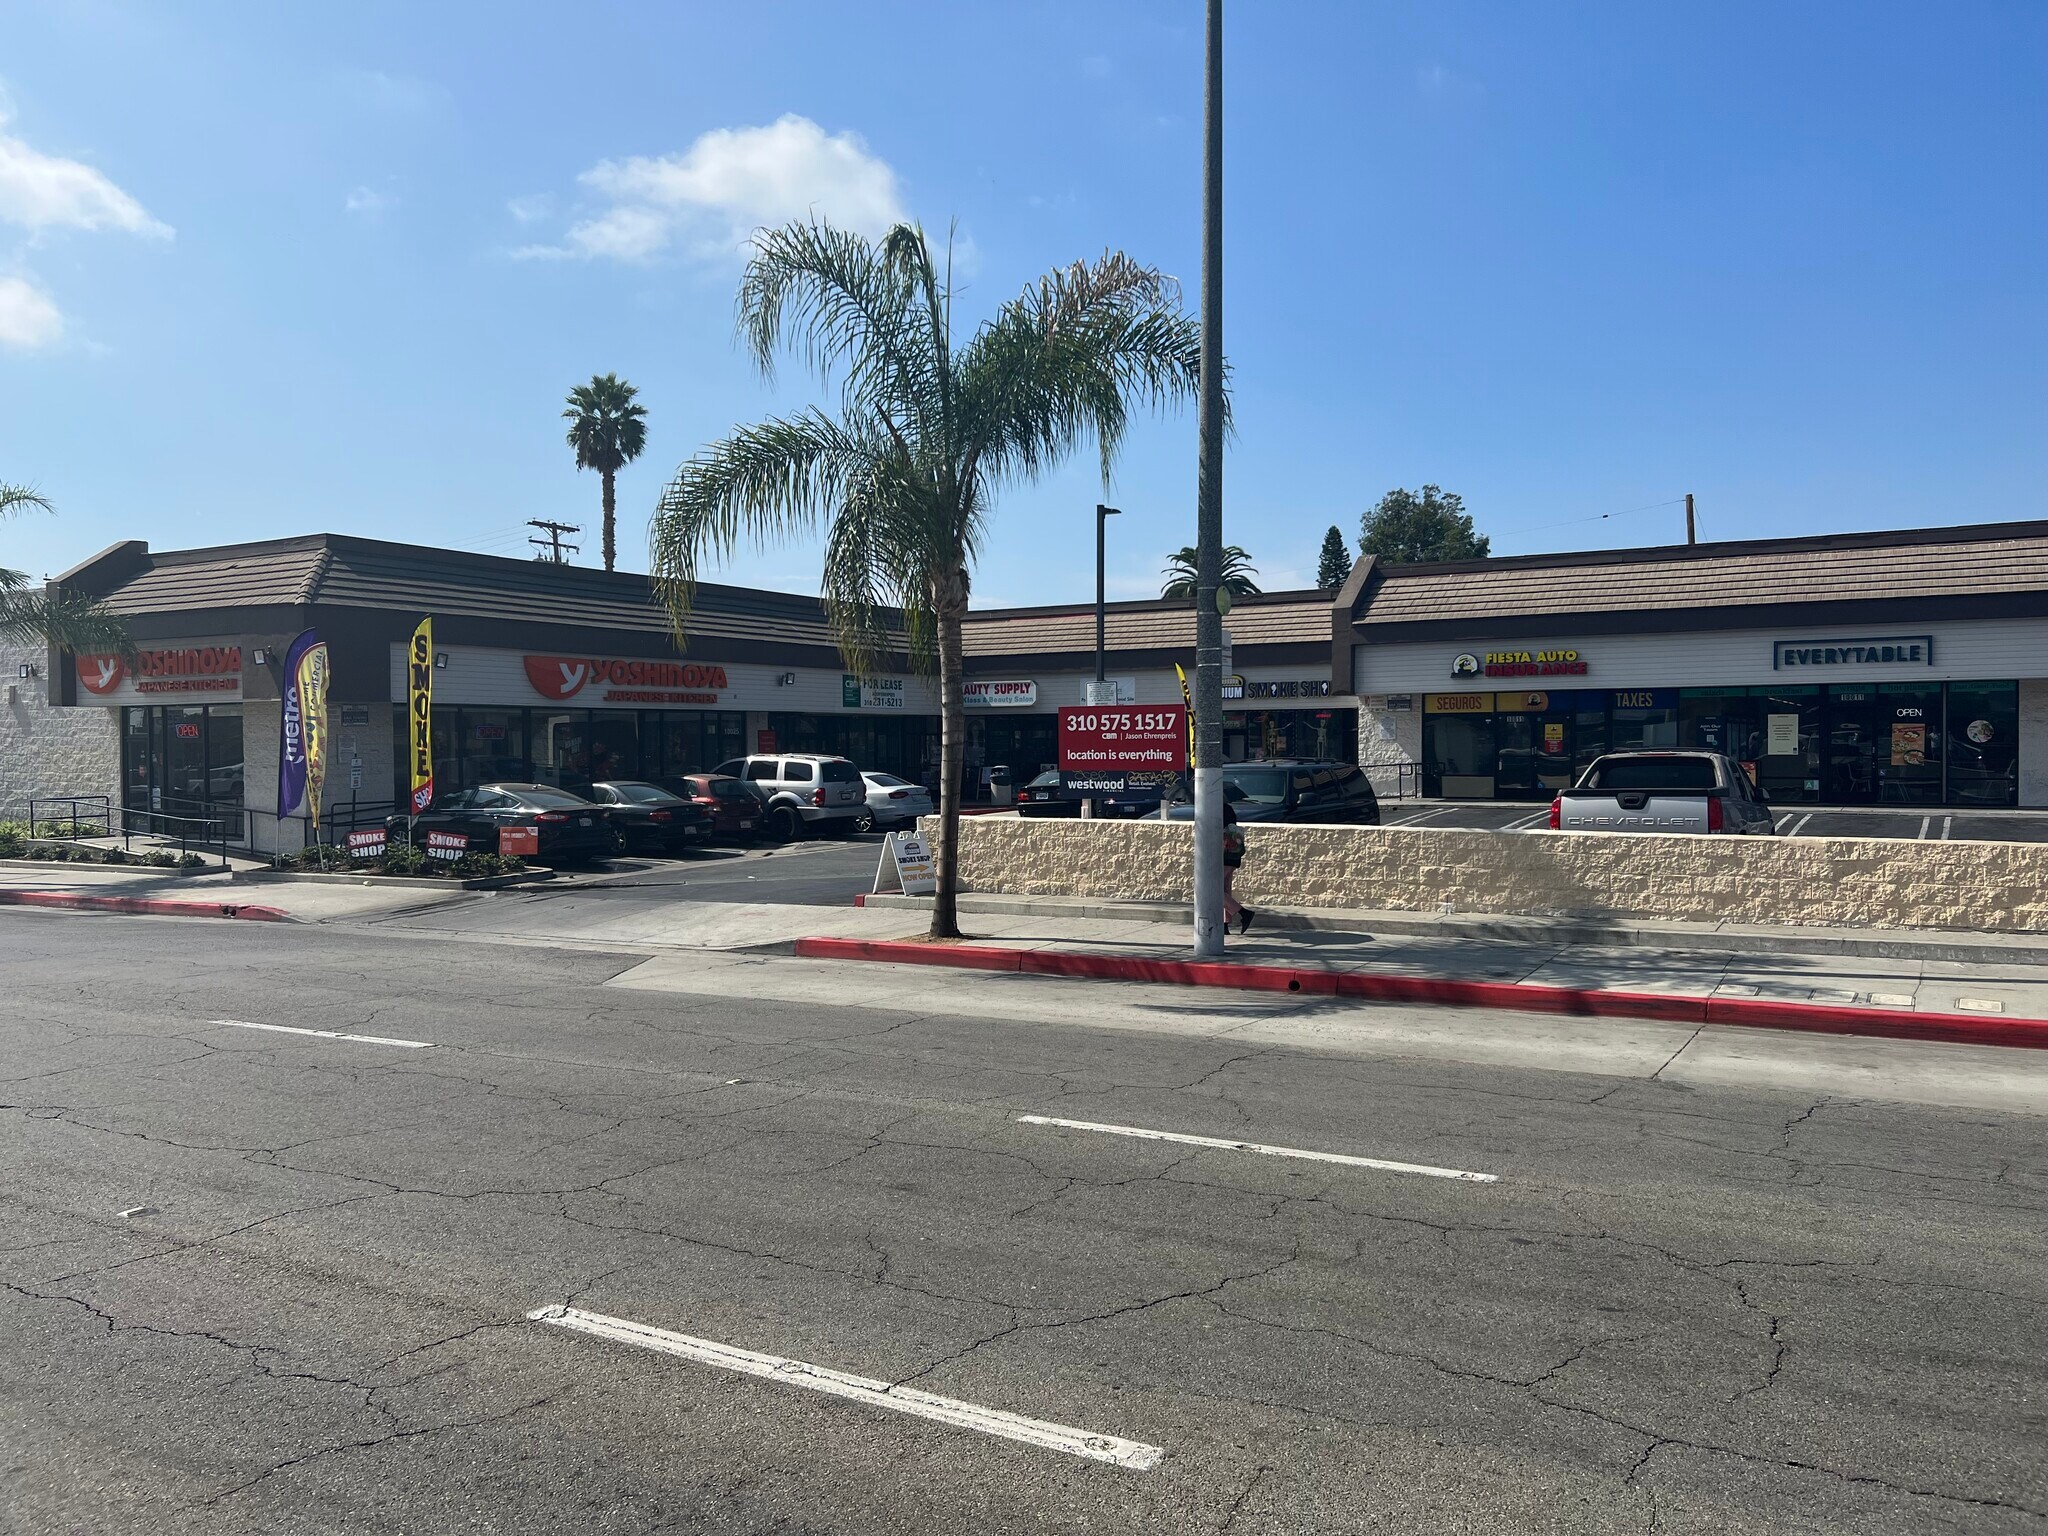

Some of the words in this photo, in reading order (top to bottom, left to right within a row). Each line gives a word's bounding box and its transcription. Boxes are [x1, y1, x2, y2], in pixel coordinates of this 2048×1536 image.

[124, 647, 241, 676] OSHINOYA
[1485, 652, 1532, 664] FIESTA
[1536, 651, 1577, 662] AUTO
[1785, 645, 1920, 665] EVERYTABLE
[592, 660, 728, 688] YOSHINOYA
[1485, 662, 1587, 677] INSURANCE
[136, 680, 186, 693] JAPANESE
[187, 679, 237, 691] KITCHEN
[863, 679, 879, 689] FOR
[880, 680, 903, 690] LEASE
[963, 683, 990, 695] AUTY
[994, 682, 1032, 695] SUPPLY
[1248, 681, 1298, 699] SMOKE
[1300, 680, 1330, 699] SHO
[603, 691, 668, 703] JAPANESE
[669, 694, 718, 704] KITCHEN
[872, 697, 903, 707] 231-5213
[989, 696, 1013, 704] Beauty
[1437, 697, 1482, 710] SEGUROS
[1616, 693, 1653, 707] TAXES
[412, 635, 430, 777] SMOKE
[1896, 708, 1923, 717] OPEN
[285, 686, 301, 760] metro
[1067, 715, 1098, 731] 310
[1100, 714, 1131, 731] 575
[1134, 713, 1177, 730] 1517
[177, 725, 199, 737] OPEN
[1125, 732, 1143, 740] Jason
[1144, 732, 1177, 740] Ehrenpreis
[1067, 749, 1106, 760] location
[1108, 749, 1117, 760] is
[1118, 749, 1173, 762] everything
[1067, 779, 1124, 790] westwood
[1567, 817, 1700, 826] CHEVROLET
[349, 832, 386, 846] SMOKE
[429, 833, 466, 848] SMOKE
[351, 844, 386, 858] SHOP
[427, 848, 464, 861] SHOP
[898, 856, 917, 864] SMOKE
[902, 873, 917, 882] NOW
